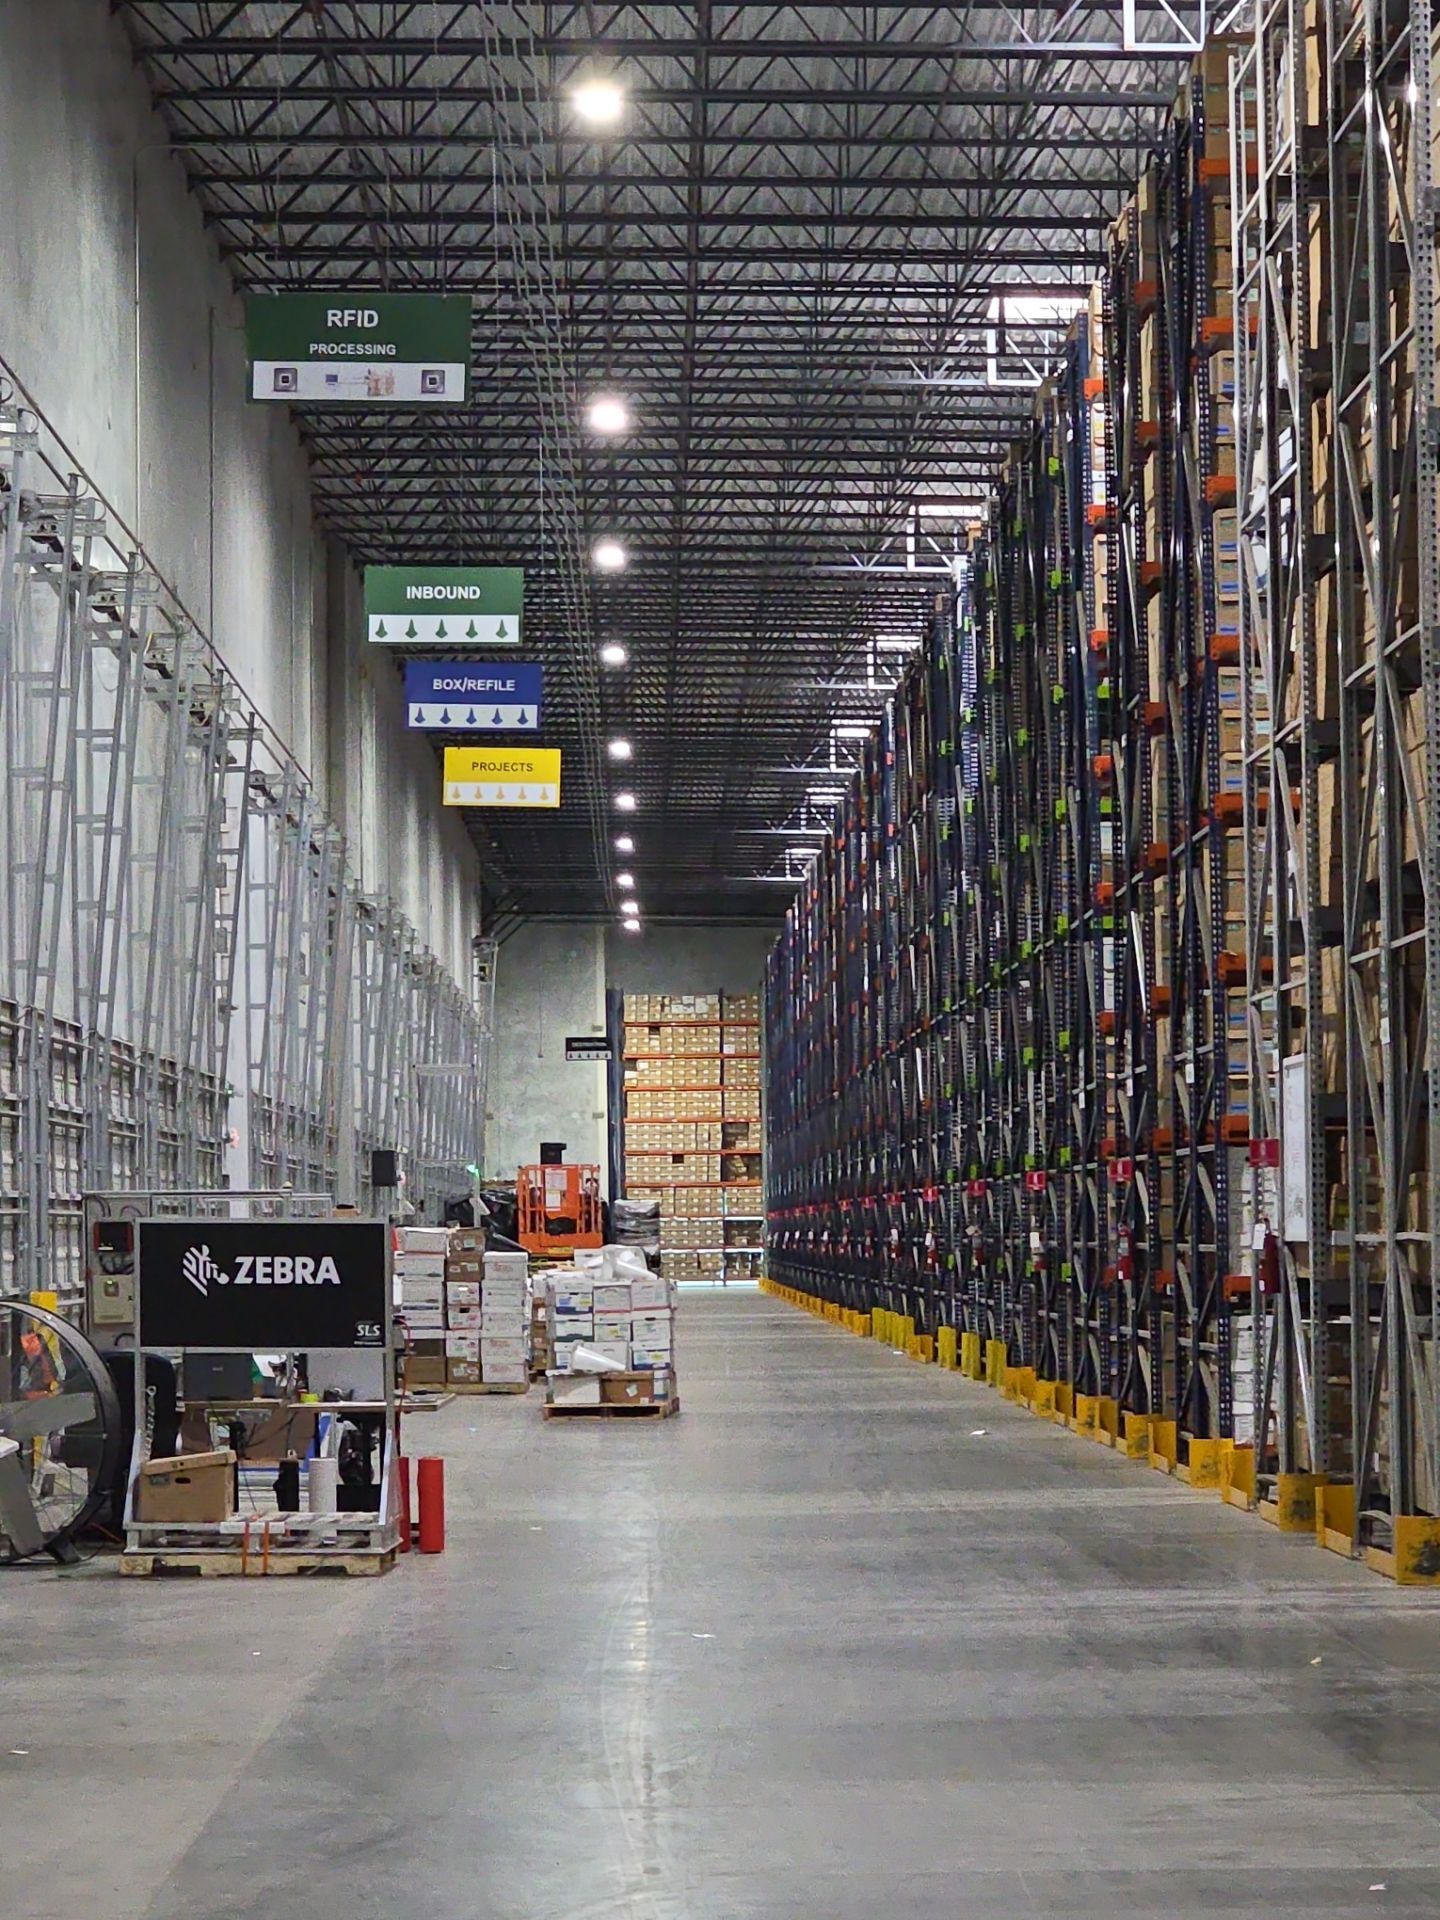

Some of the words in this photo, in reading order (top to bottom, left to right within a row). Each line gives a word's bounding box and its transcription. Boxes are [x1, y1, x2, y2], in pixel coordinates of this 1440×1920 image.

[327, 309, 379, 328] RFID
[309, 343, 397, 356] PROCESSING
[406, 585, 481, 600] INBOUND
[432, 677, 515, 693] BOX/REFILE
[471, 761, 534, 773] PROJECTS
[233, 1256, 341, 1285] ZEBRA
[356, 1324, 381, 1337] SLS
